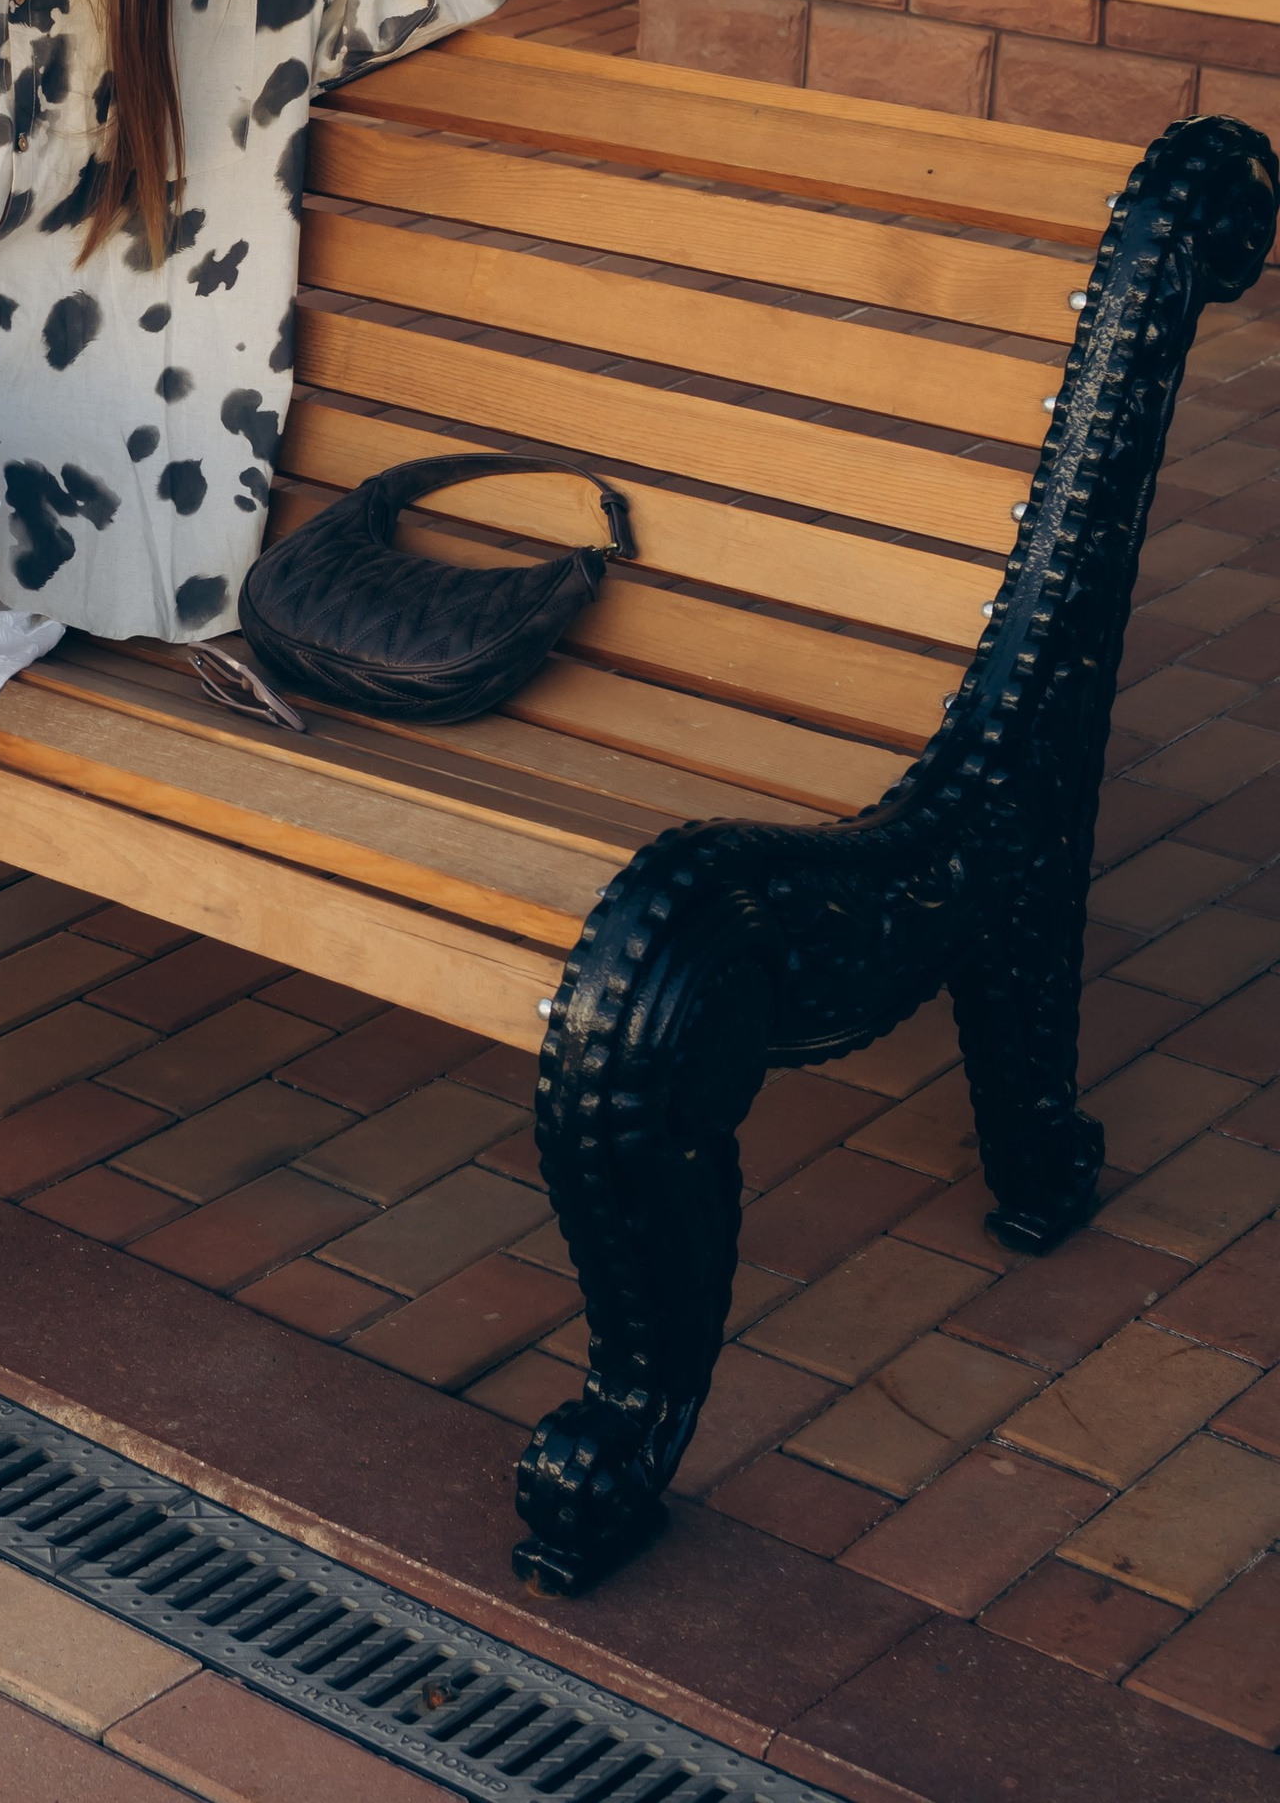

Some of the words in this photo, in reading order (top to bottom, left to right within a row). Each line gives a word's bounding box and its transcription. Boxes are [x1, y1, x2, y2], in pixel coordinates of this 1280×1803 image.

[250, 1660, 298, 1687] C250
[380, 1593, 484, 1650] GIDROLICA
[587, 1690, 638, 1718] C250
[399, 1733, 508, 1793] GIDROLICA
